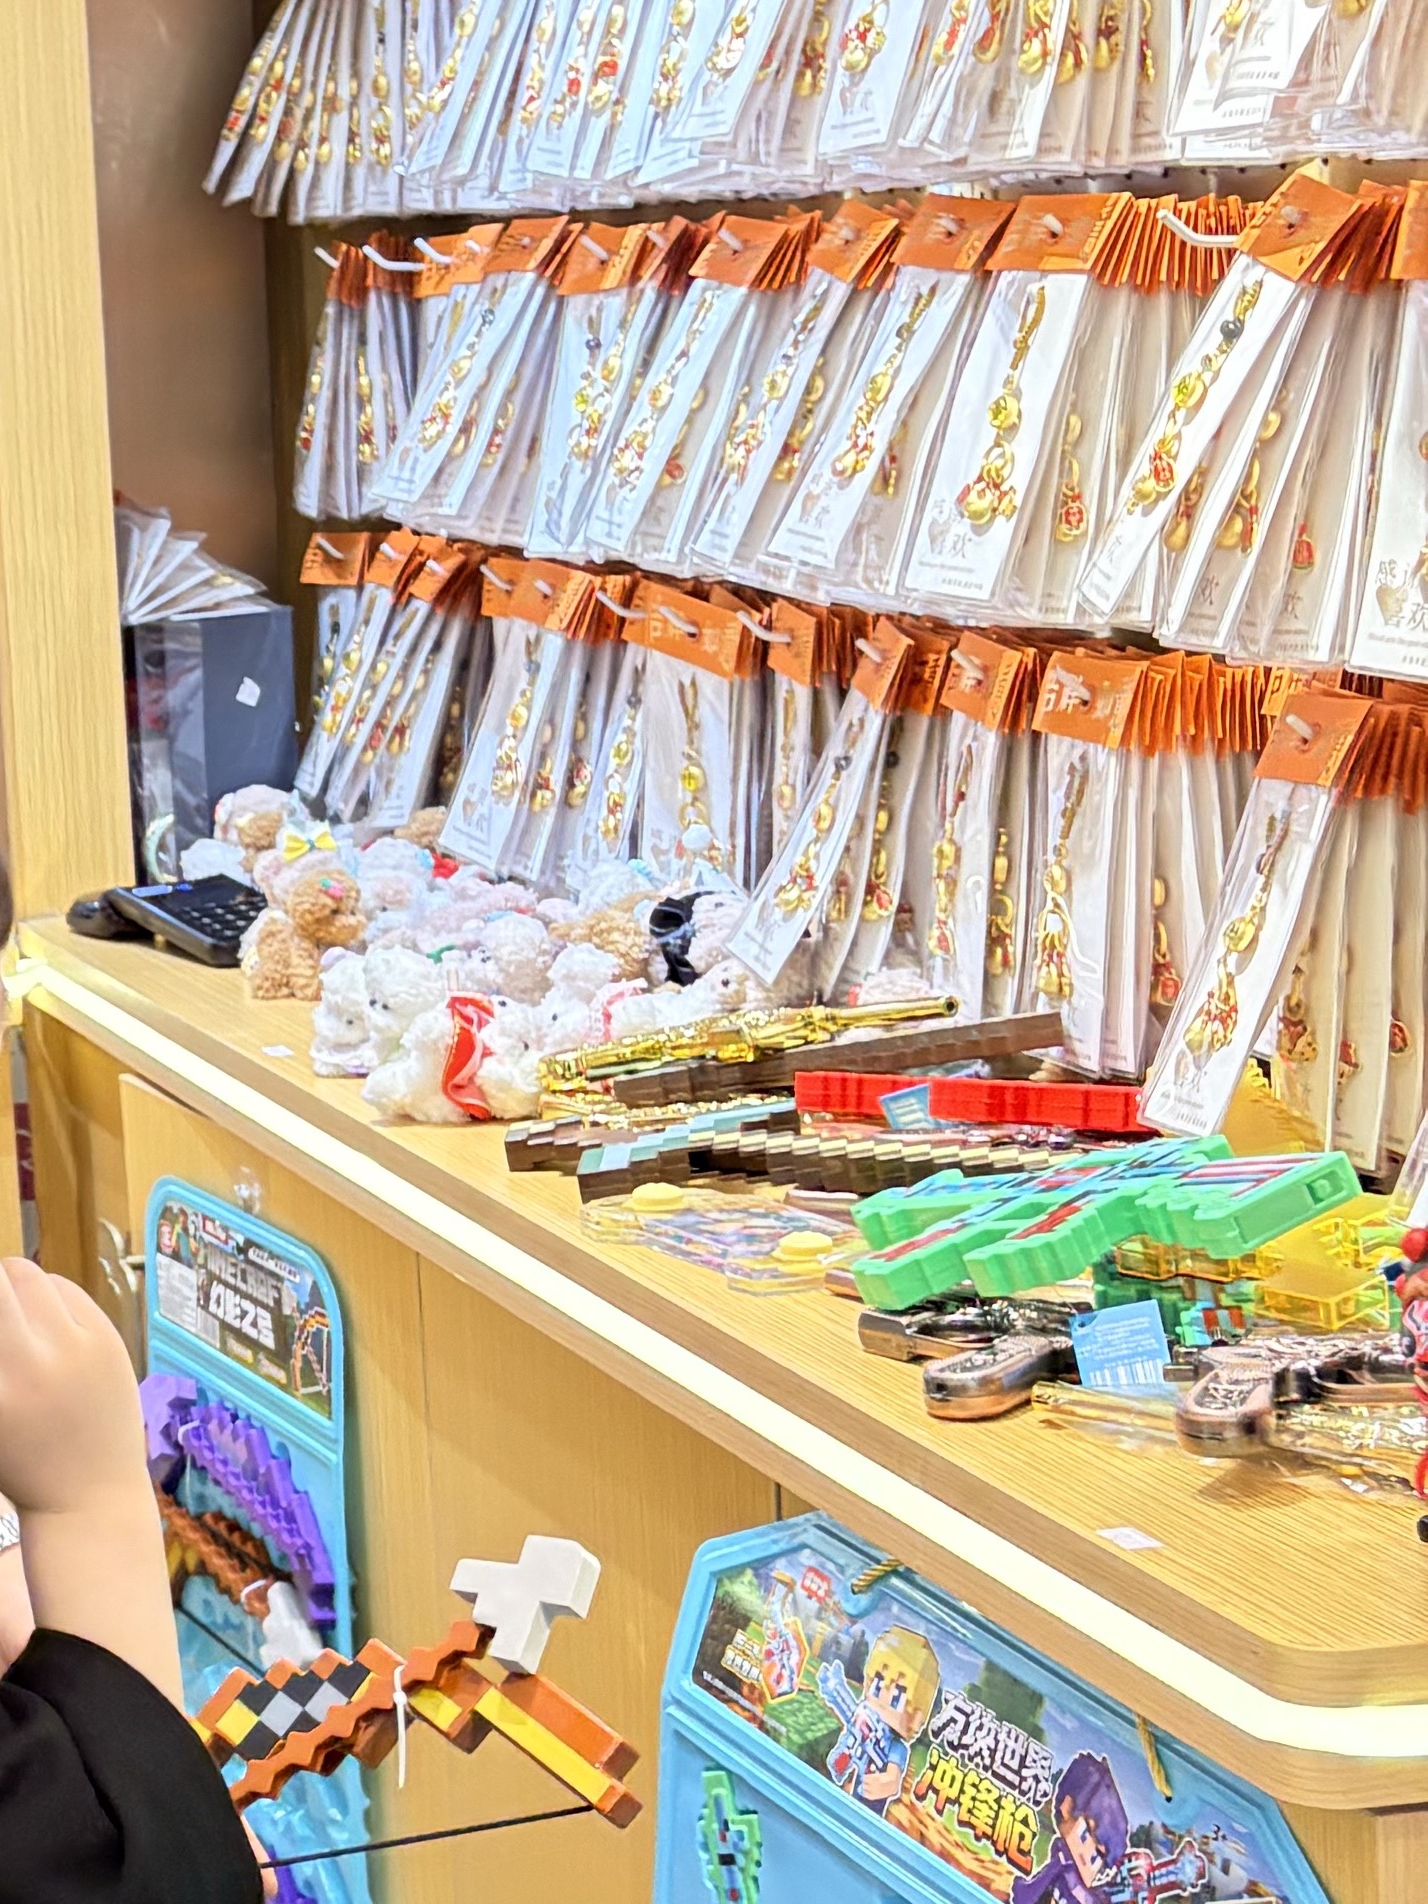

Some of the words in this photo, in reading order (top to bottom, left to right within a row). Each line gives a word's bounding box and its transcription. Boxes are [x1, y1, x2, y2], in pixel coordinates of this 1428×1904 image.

[914, 1747, 1038, 1875] 冲锋枪
[929, 1692, 1053, 1809] 方块世界
